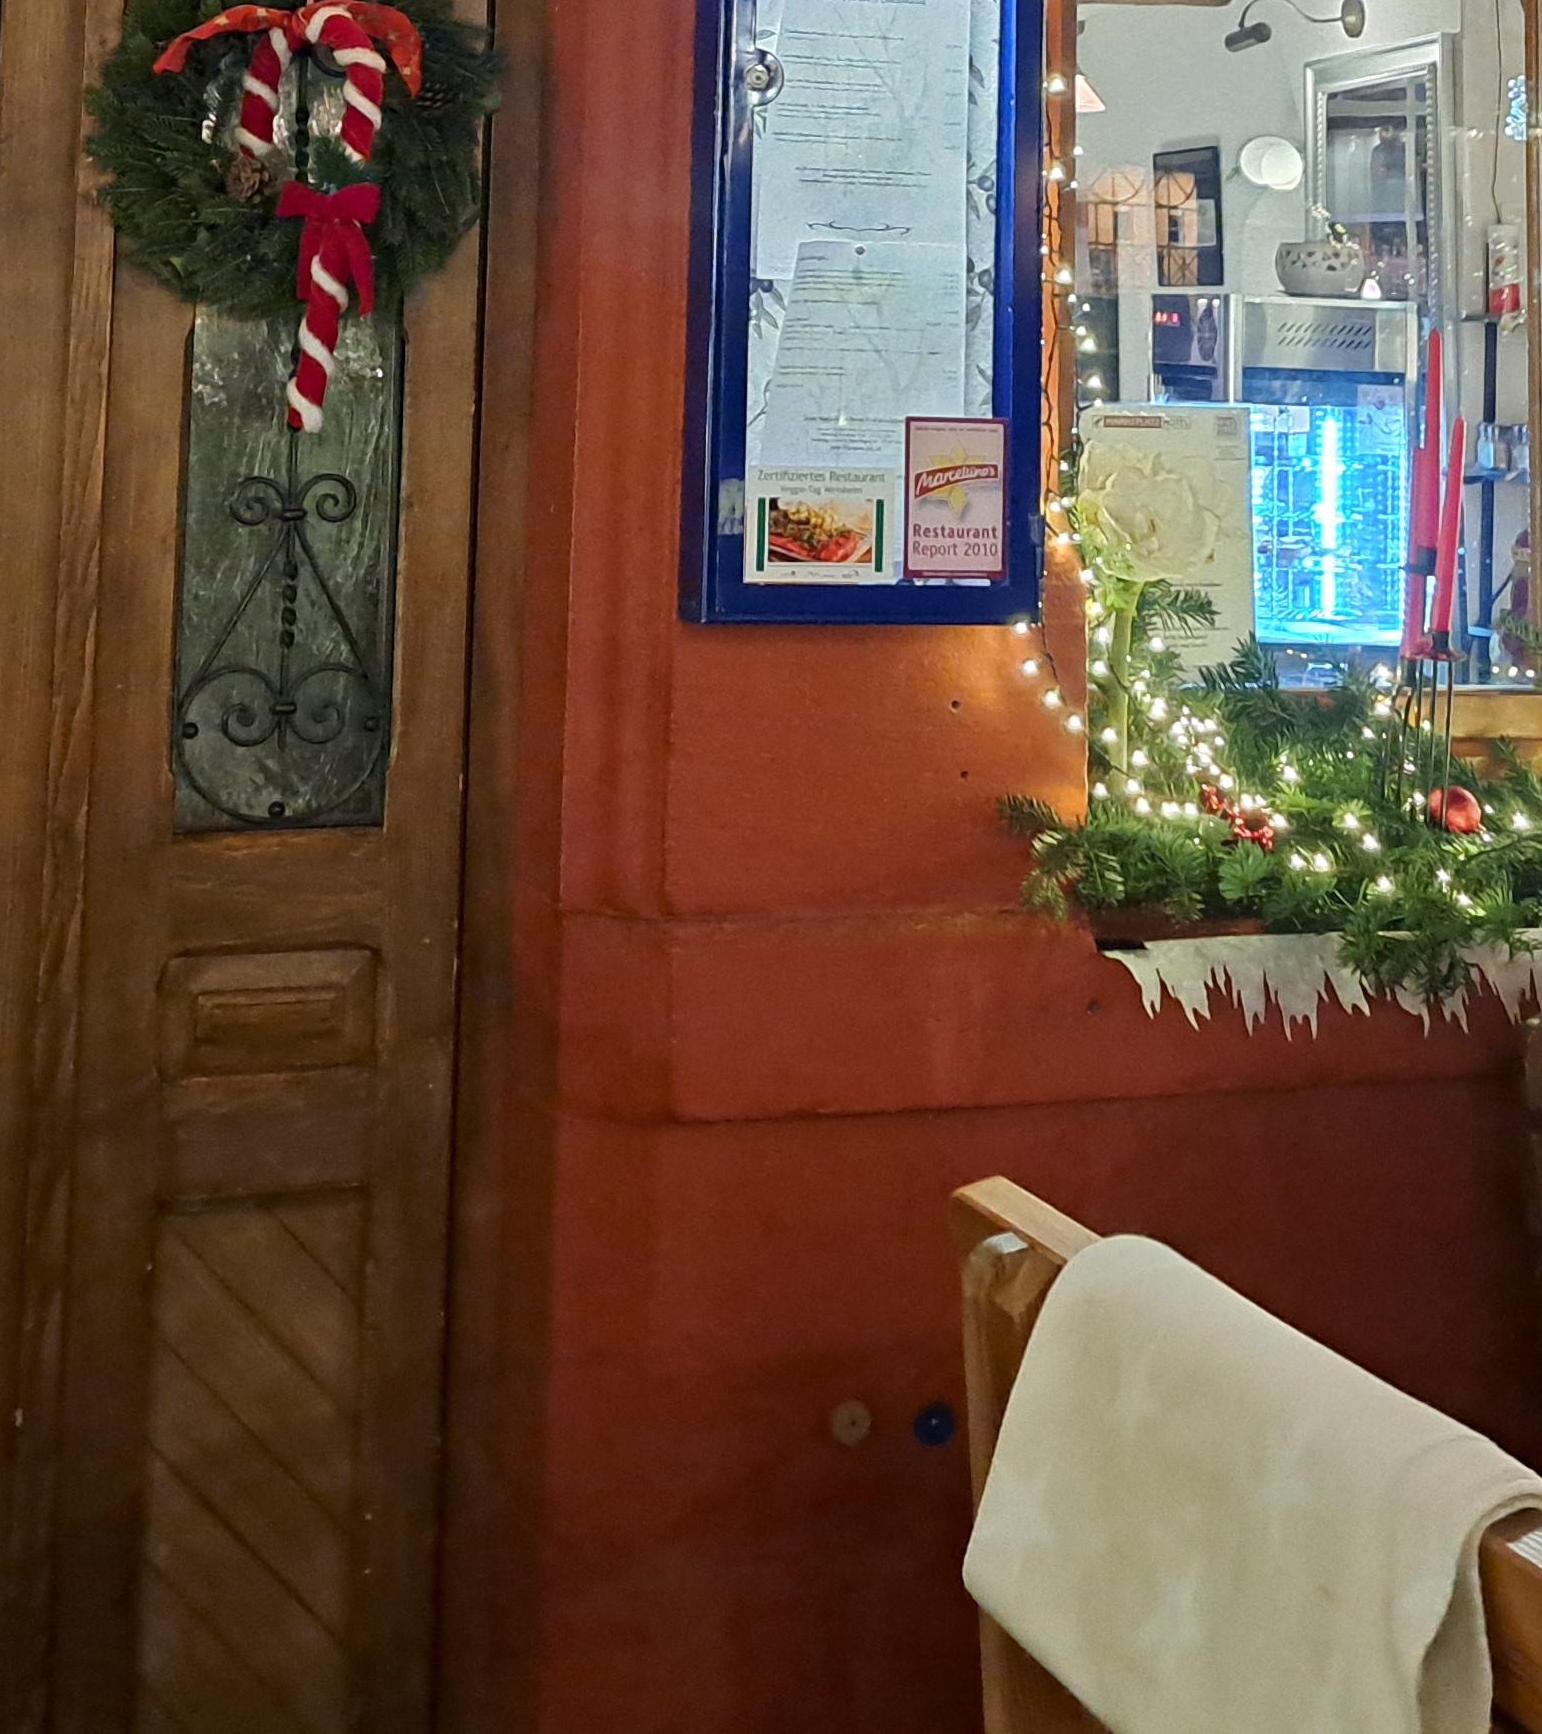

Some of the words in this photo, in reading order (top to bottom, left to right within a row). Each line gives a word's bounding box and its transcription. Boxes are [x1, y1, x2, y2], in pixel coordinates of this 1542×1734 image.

[829, 470, 886, 484] Restaurant
[912, 523, 999, 540] Restaurant
[912, 540, 959, 559] Report
[963, 541, 999, 557] 2010
